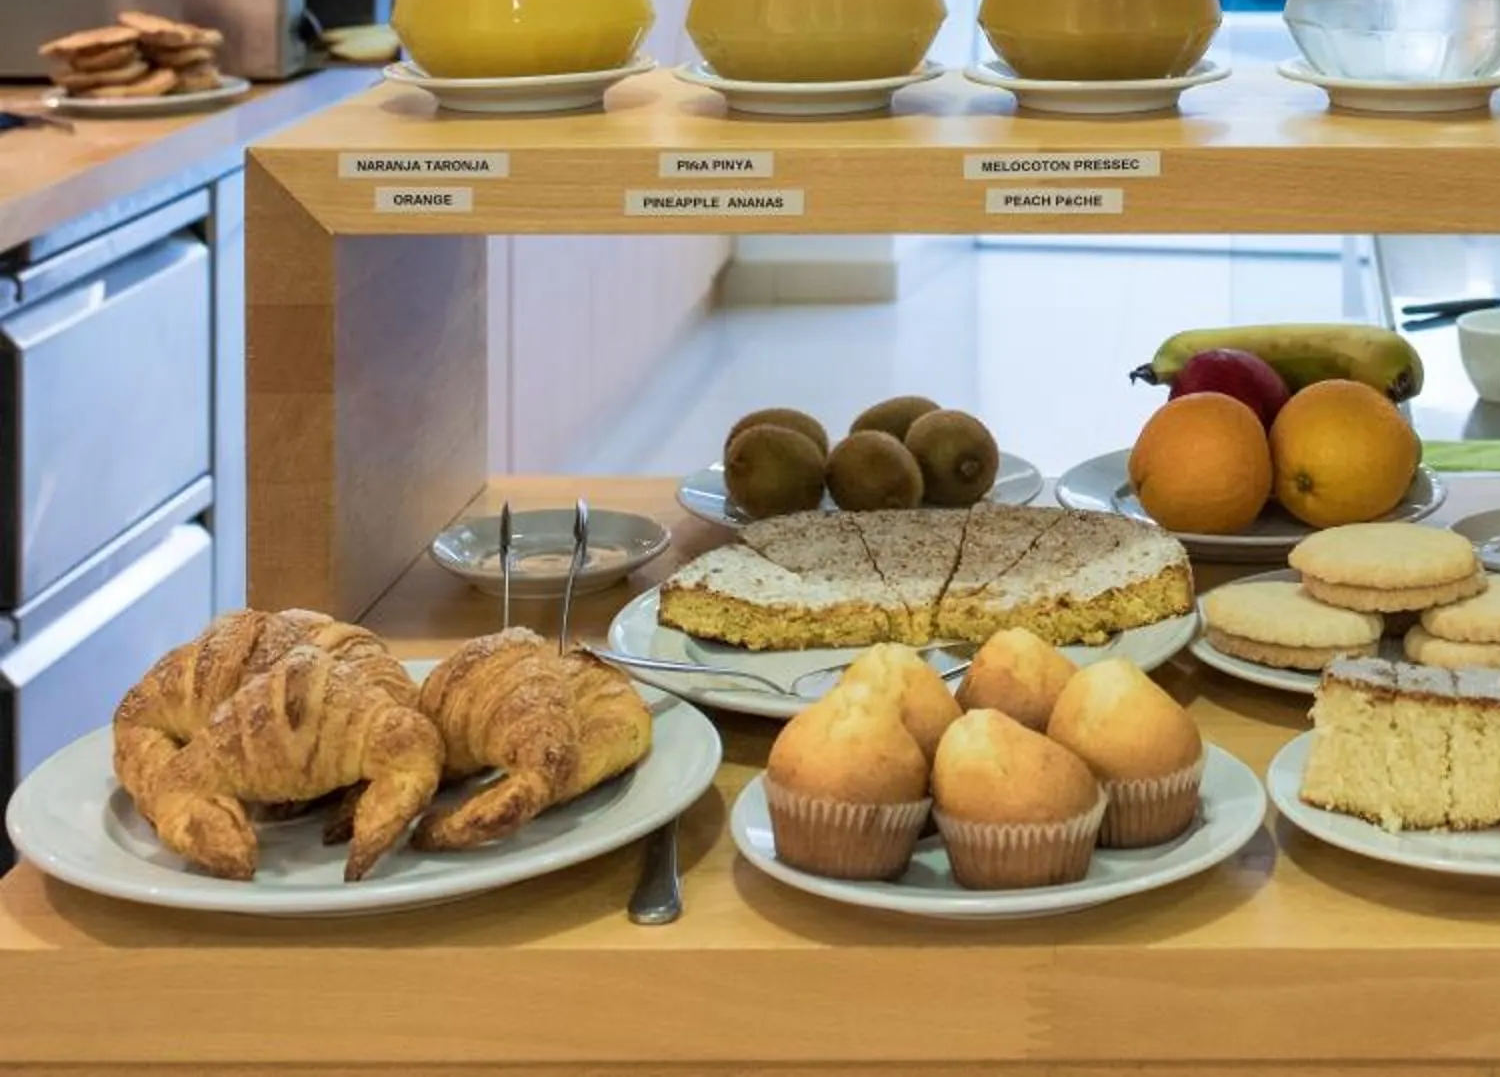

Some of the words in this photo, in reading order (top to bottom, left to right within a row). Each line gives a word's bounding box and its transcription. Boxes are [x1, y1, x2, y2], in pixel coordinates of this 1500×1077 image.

[357, 160, 421, 172] NARANJA
[426, 159, 490, 172] TARONJA
[713, 159, 754, 171] PINYA
[981, 159, 1071, 173] MELOCOTON
[1073, 158, 1140, 171] PRESSEC
[393, 194, 453, 206] ORANGE
[643, 197, 720, 209] PINEAPPLE
[727, 197, 784, 209] ANANAS
[1004, 194, 1051, 207] PEACH
